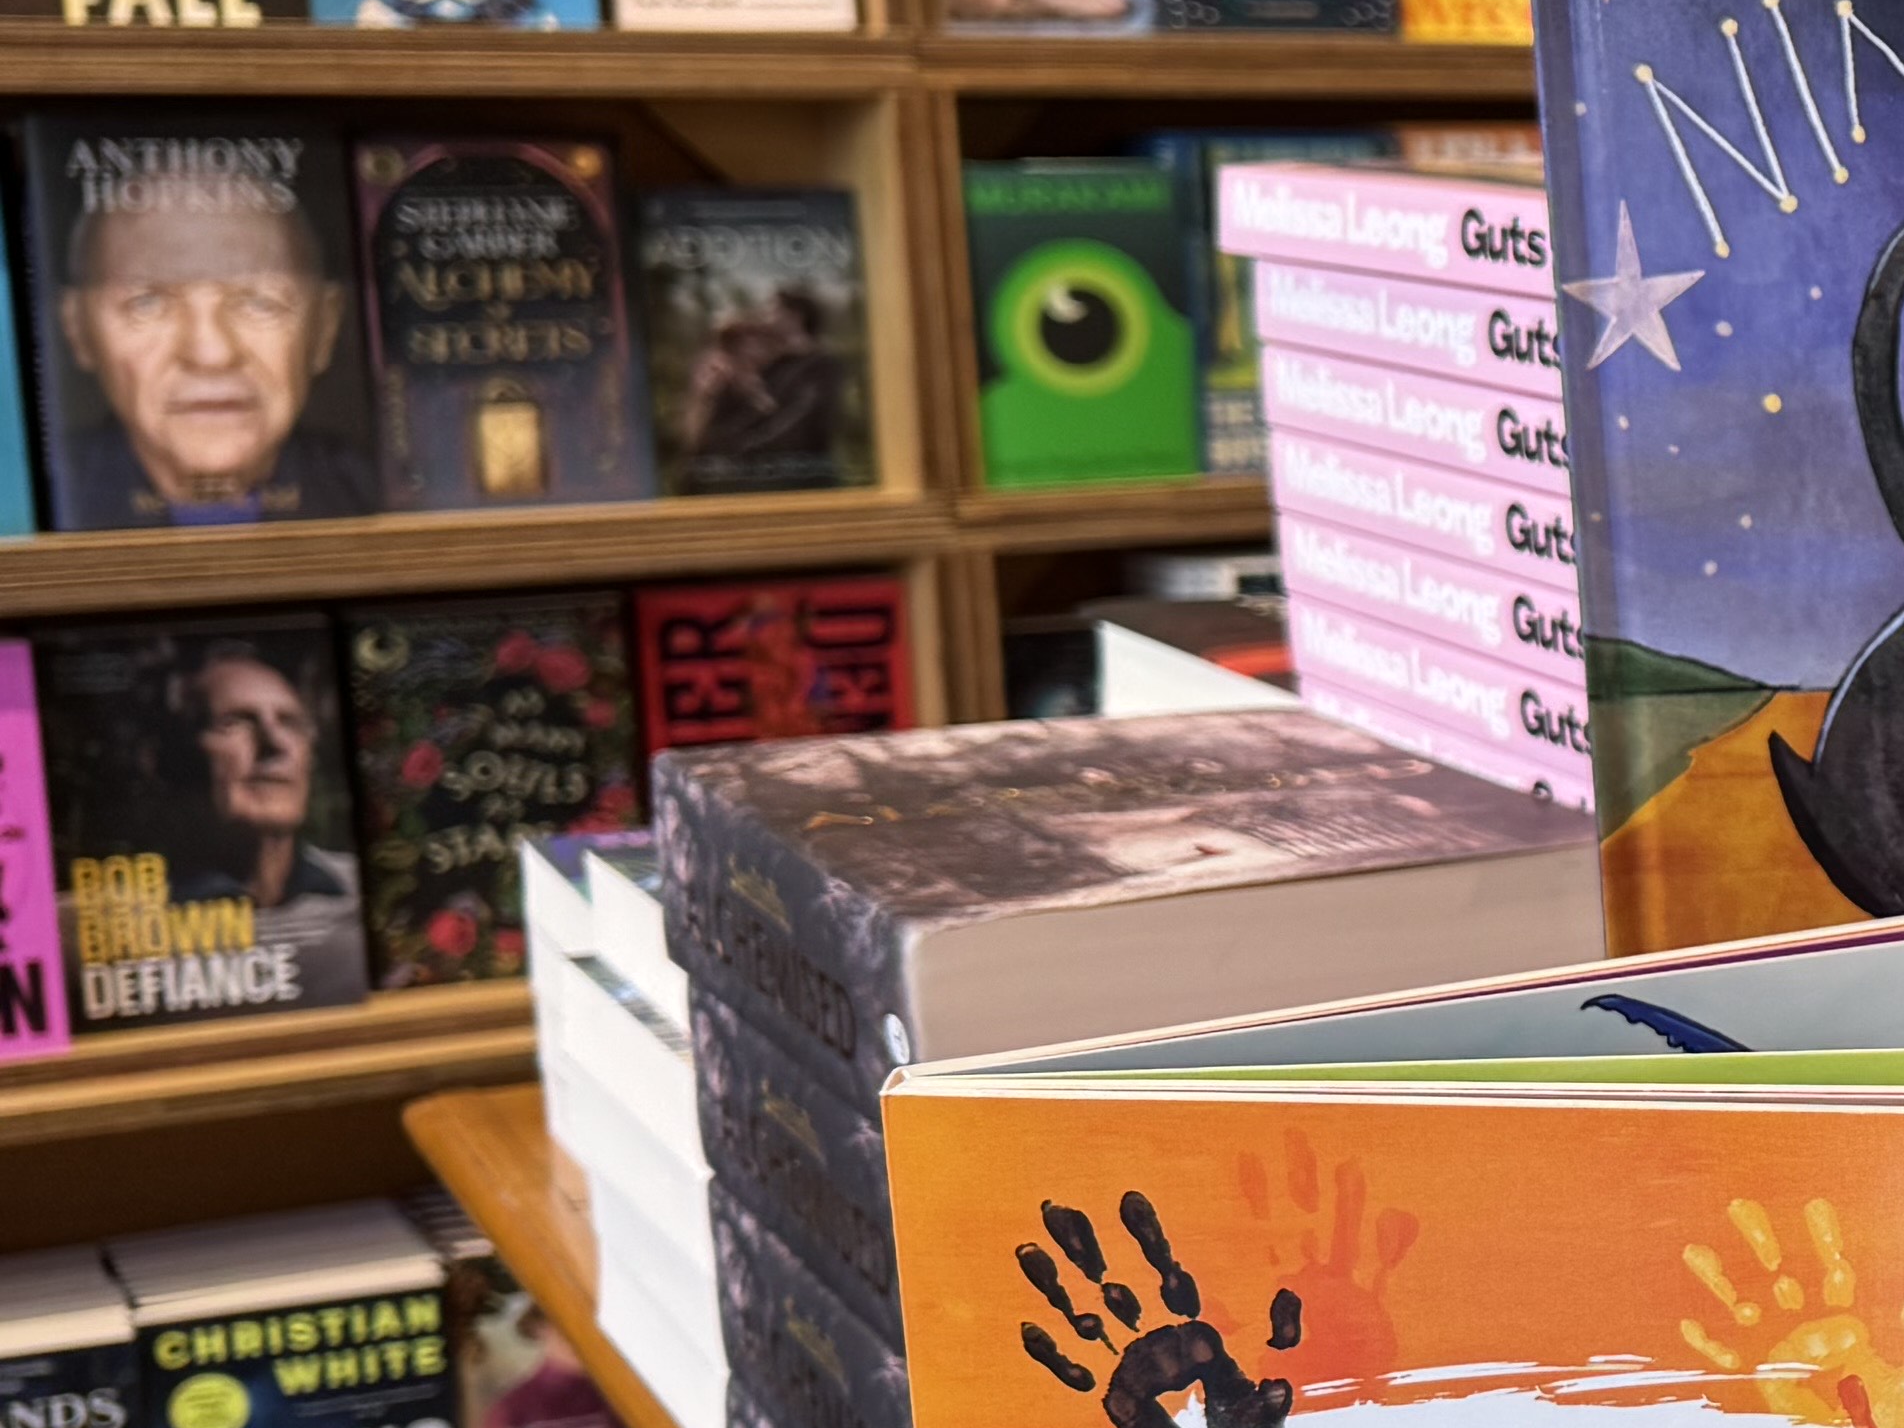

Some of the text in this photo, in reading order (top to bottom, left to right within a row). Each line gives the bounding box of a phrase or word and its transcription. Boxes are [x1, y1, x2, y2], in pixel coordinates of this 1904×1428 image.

[1229, 182, 1547, 268] Melissa Leong Guts
[71, 853, 167, 905] BOB
[76, 897, 254, 964] BROWN
[82, 944, 298, 1020] DEFIANCE
[153, 1294, 443, 1372] CHRISTIAN
[274, 1336, 446, 1398] WHITE
